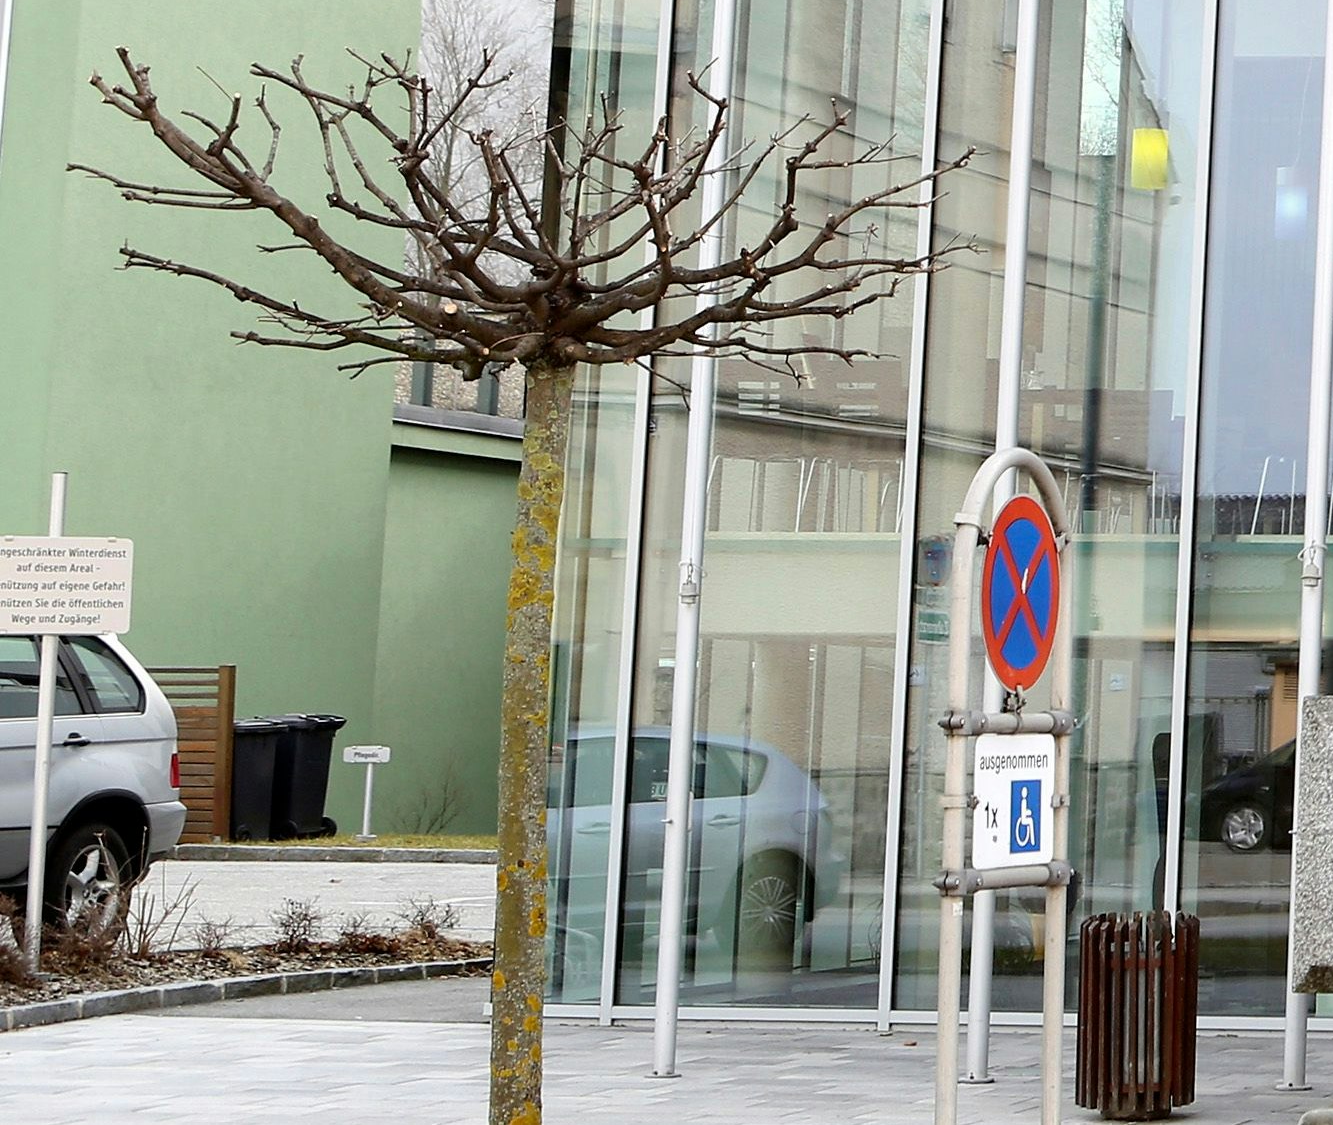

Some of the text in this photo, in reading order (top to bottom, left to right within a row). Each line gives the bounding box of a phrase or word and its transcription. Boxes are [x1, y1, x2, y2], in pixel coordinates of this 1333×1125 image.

[69, 548, 127, 558] Winterdienst
[16, 563, 32, 572] auf
[34, 563, 67, 572] diesem
[69, 563, 94, 573] Areal
[0, 580, 126, 592] nützung auf eigene Gefahr!
[0, 598, 124, 608] nützen Sie die öffentlichen
[11, 614, 101, 625] Wege und Zugänge!
[979, 754, 1048, 774] ausgenommen
[984, 801, 998, 829] 1x
